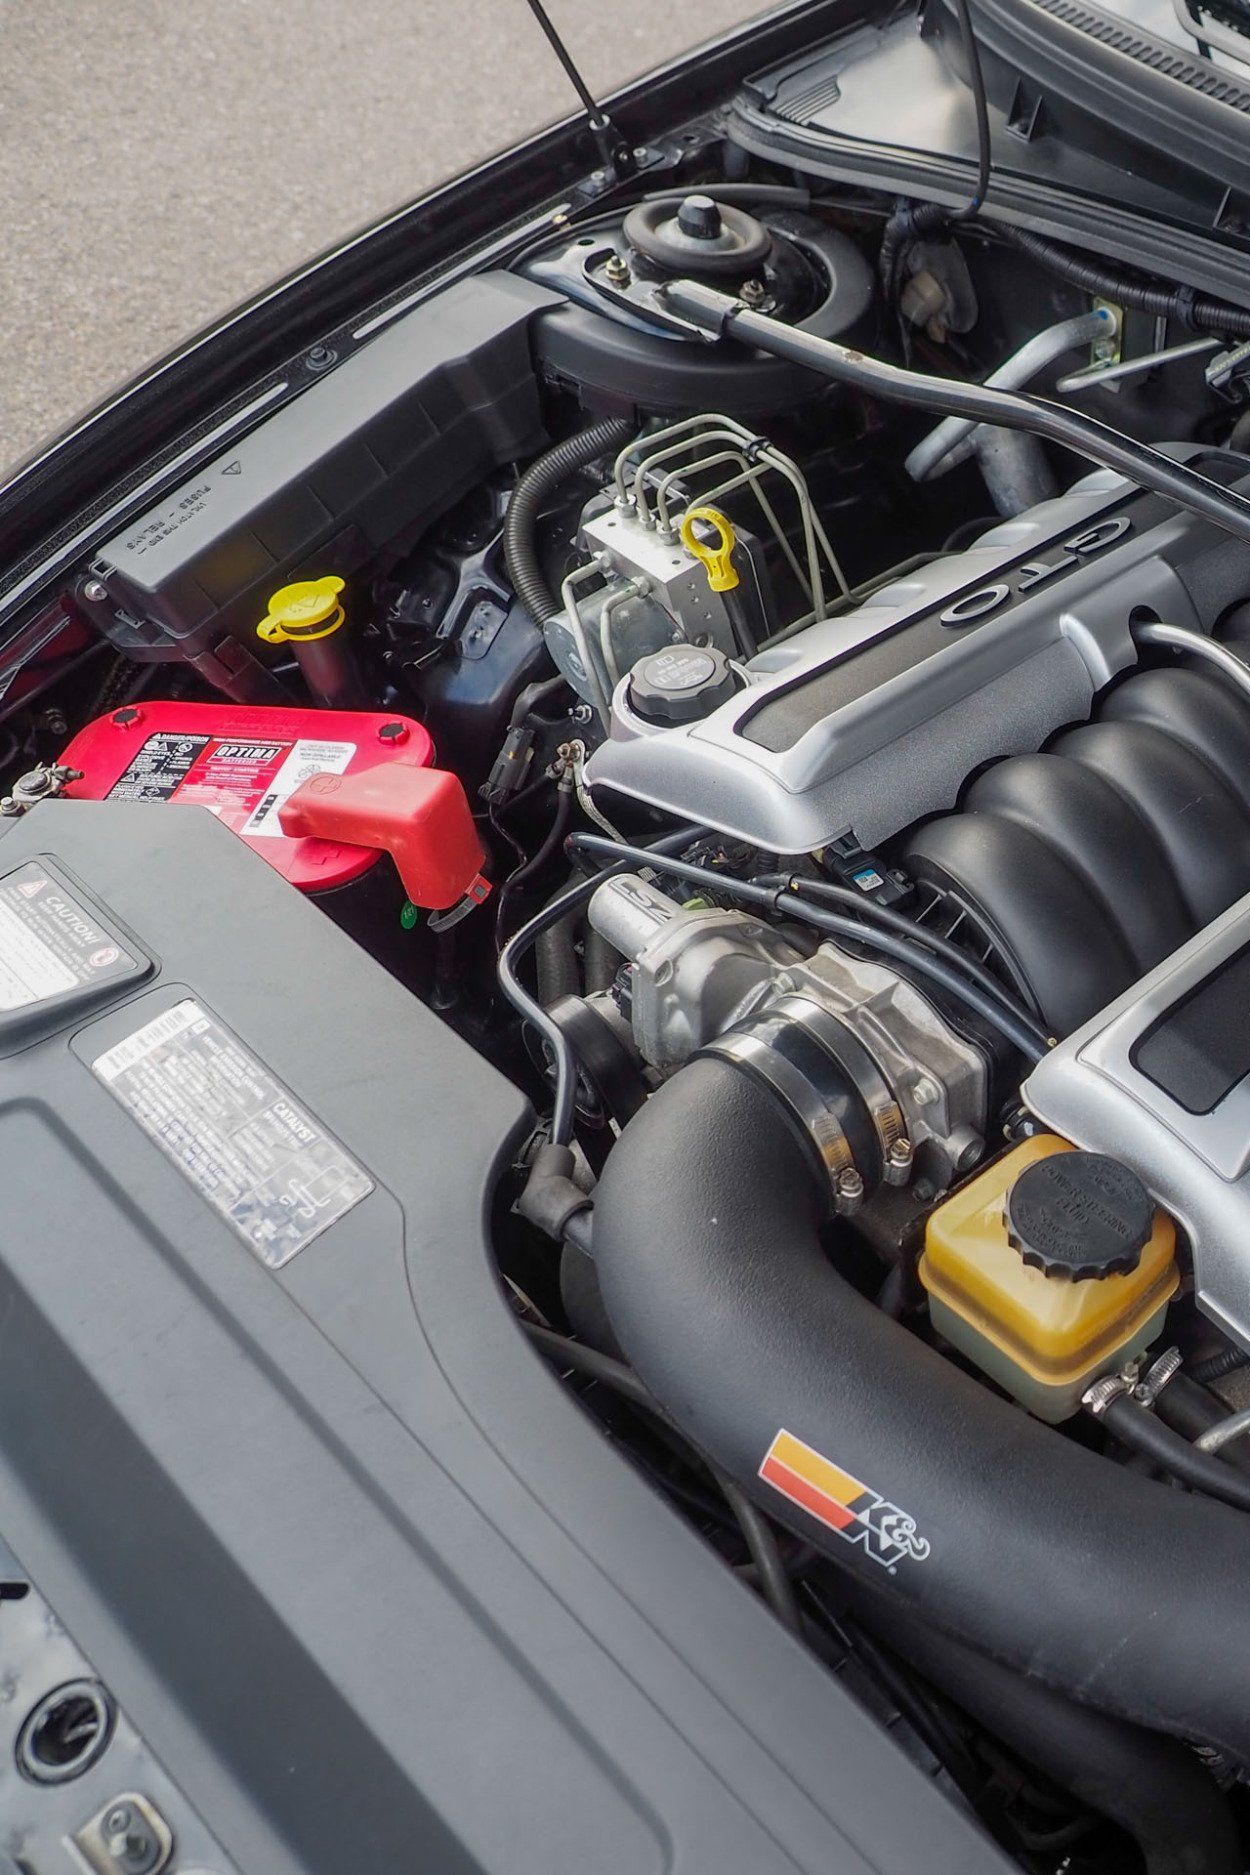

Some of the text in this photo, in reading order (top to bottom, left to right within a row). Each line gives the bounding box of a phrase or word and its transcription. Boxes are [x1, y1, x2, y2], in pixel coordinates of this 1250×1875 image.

[180, 485, 211, 510] FUSES
[126, 521, 165, 550] RELAYS
[941, 517, 1131, 628] GTO
[216, 745, 278, 759] OPTIMA
[46, 896, 100, 944] CAUTION!
[272, 1102, 316, 1142] CATALYST
